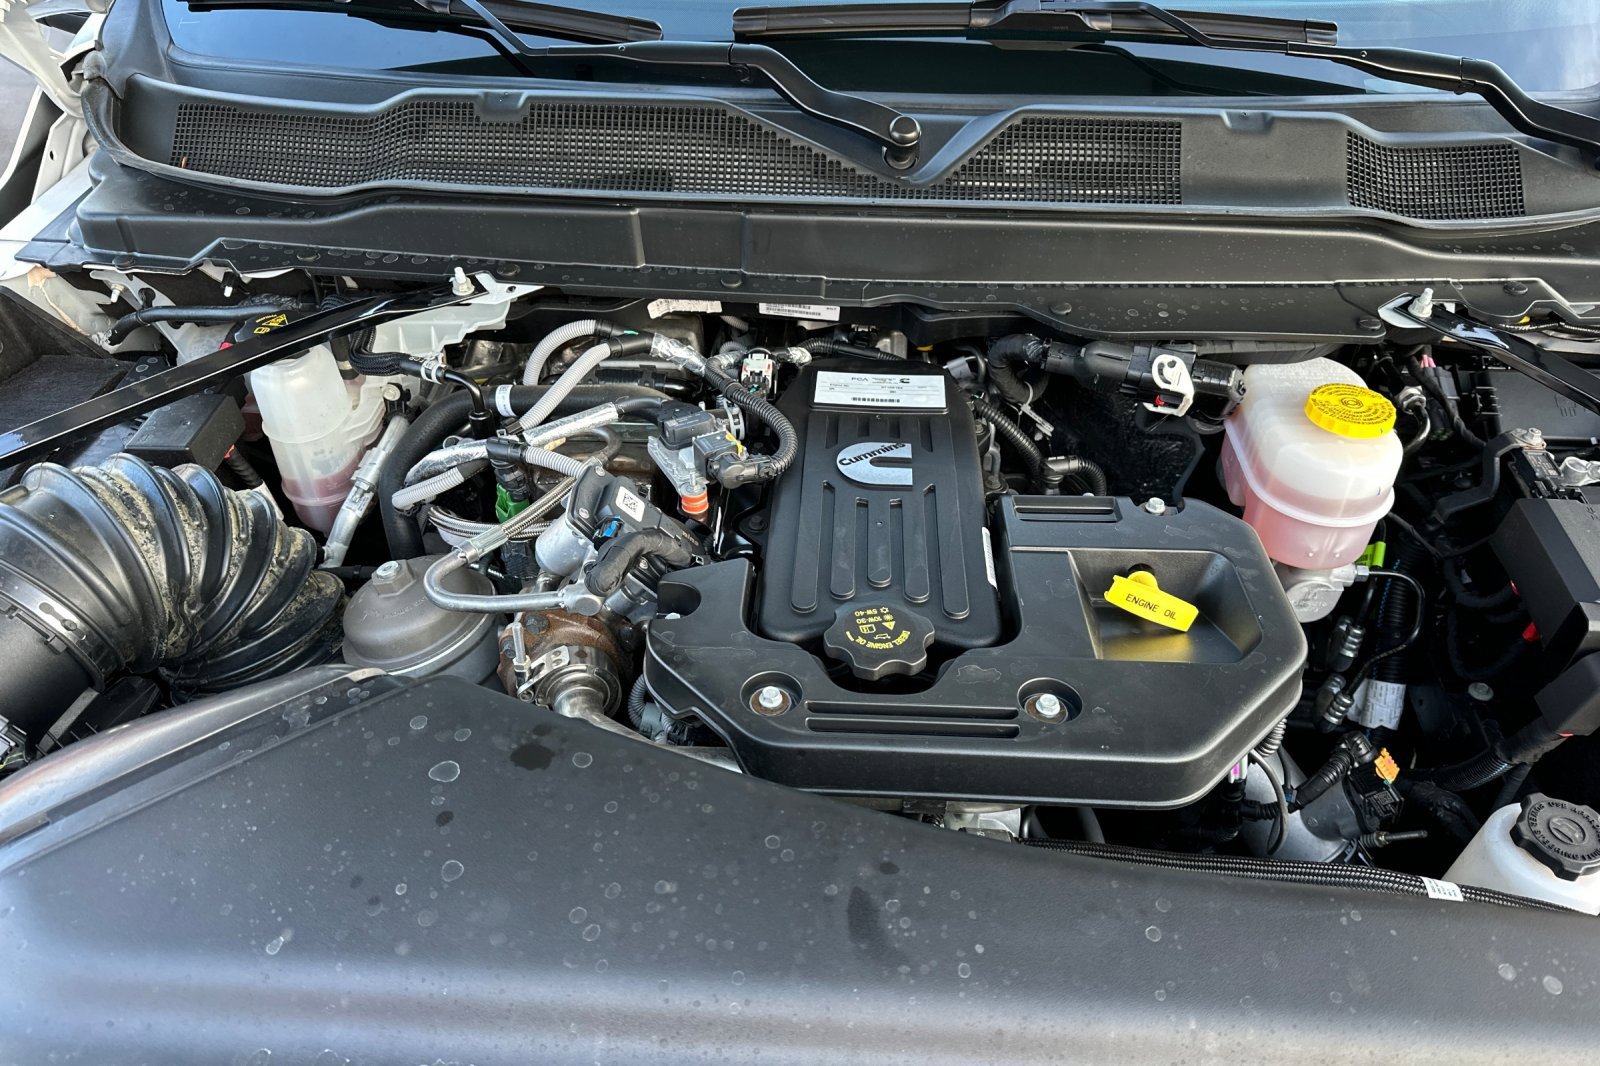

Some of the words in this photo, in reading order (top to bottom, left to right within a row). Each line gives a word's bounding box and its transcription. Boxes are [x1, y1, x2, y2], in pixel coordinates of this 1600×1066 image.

[838, 442, 907, 466] Cummins
[1125, 593, 1160, 613] ENGINE
[1163, 609, 1177, 620] OIL
[865, 641, 894, 650] ENGINE
